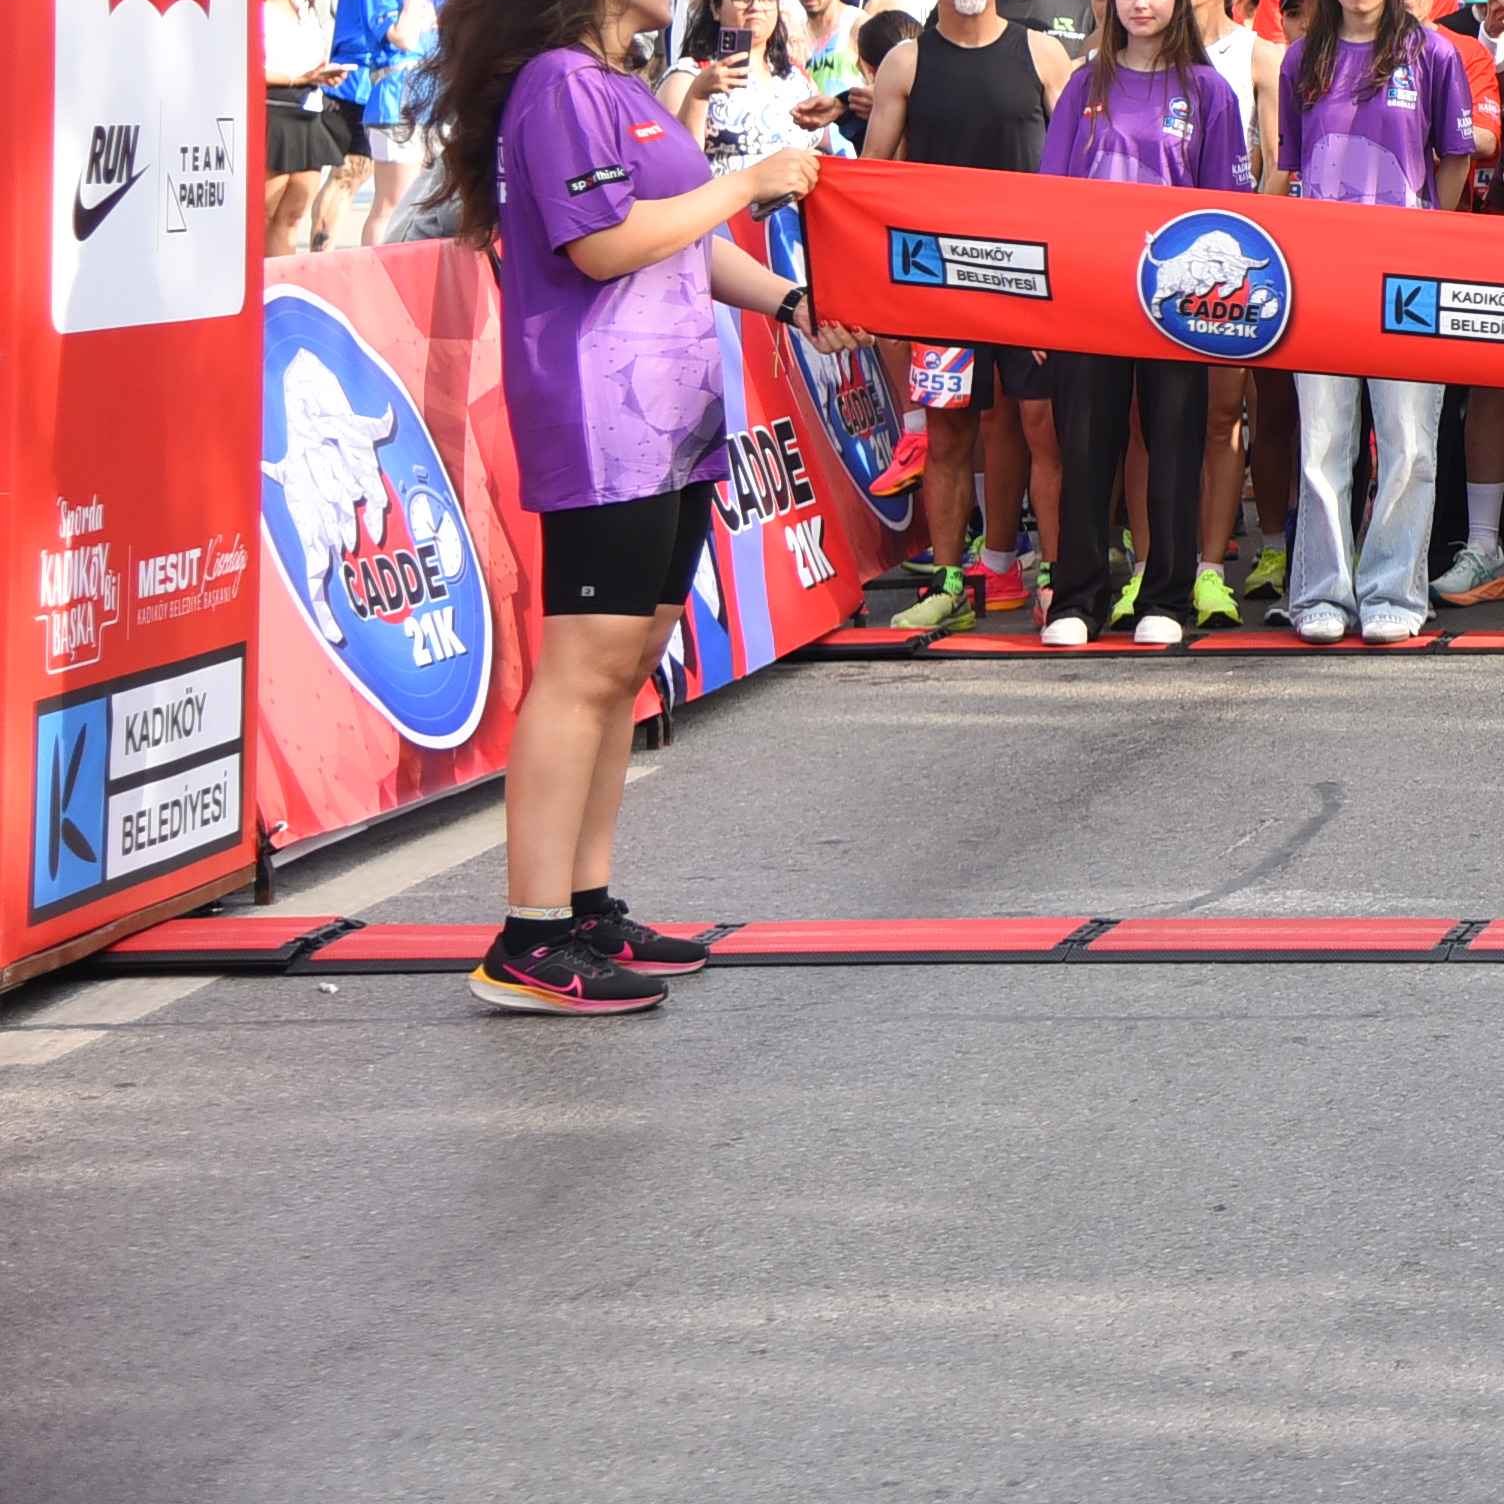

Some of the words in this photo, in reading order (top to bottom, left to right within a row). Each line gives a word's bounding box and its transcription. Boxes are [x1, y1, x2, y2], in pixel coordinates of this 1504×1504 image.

[86, 125, 141, 186] RUN
[179, 146, 225, 172] TEAM
[949, 242, 1014, 264] KADIKÖY
[955, 268, 1038, 293] BELEDİYESİ
[1177, 296, 1260, 324] CADDE
[1186, 319, 1258, 339] 10K-21K
[830, 382, 888, 436] CADDE
[911, 369, 962, 392] 4253
[712, 416, 816, 536] CADDE
[57, 494, 104, 540] Sporda
[40, 541, 110, 609] KADIKÖY
[138, 546, 202, 600] MESUT
[784, 515, 838, 590] 21K
[343, 542, 447, 622] CADDE
[51, 600, 97, 662] BAŞKA
[403, 604, 468, 668] 21K
[125, 686, 208, 756] KADIKÖY
[121, 770, 229, 857] BELEDİYESİ
